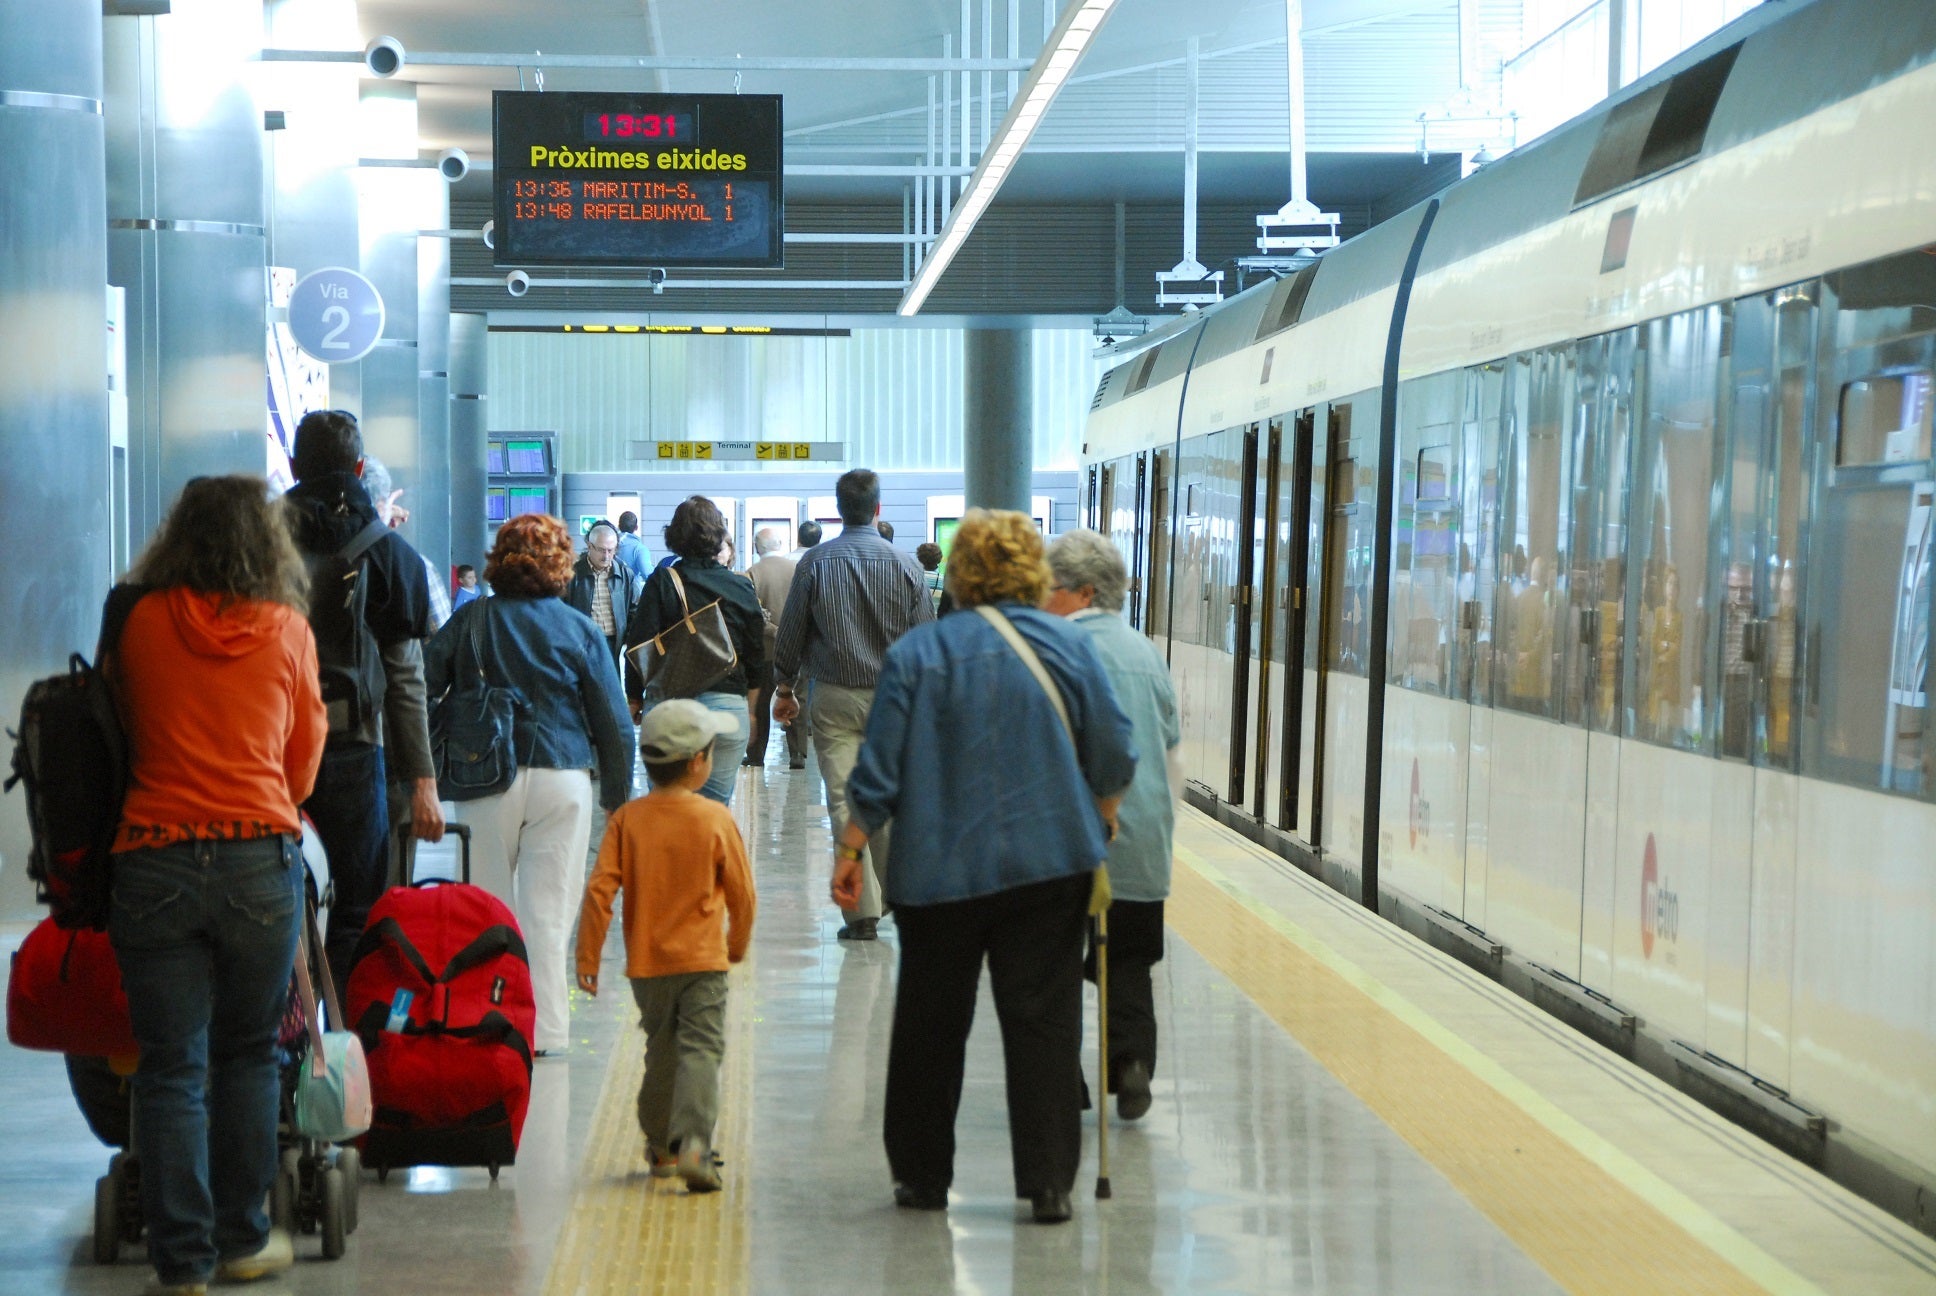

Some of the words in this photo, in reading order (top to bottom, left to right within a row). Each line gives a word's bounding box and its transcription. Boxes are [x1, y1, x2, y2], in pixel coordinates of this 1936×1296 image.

[599, 113, 676, 137] 13:31
[530, 146, 649, 169] Pròximes
[657, 148, 747, 171] eixides
[515, 180, 572, 198] 13:36
[583, 182, 697, 199] MARITIM-S.
[725, 184, 734, 199] 1
[515, 202, 572, 220] 13:48
[583, 203, 711, 221] RAFELBUNYOL
[725, 205, 734, 221] 1
[321, 306, 350, 349] 2
